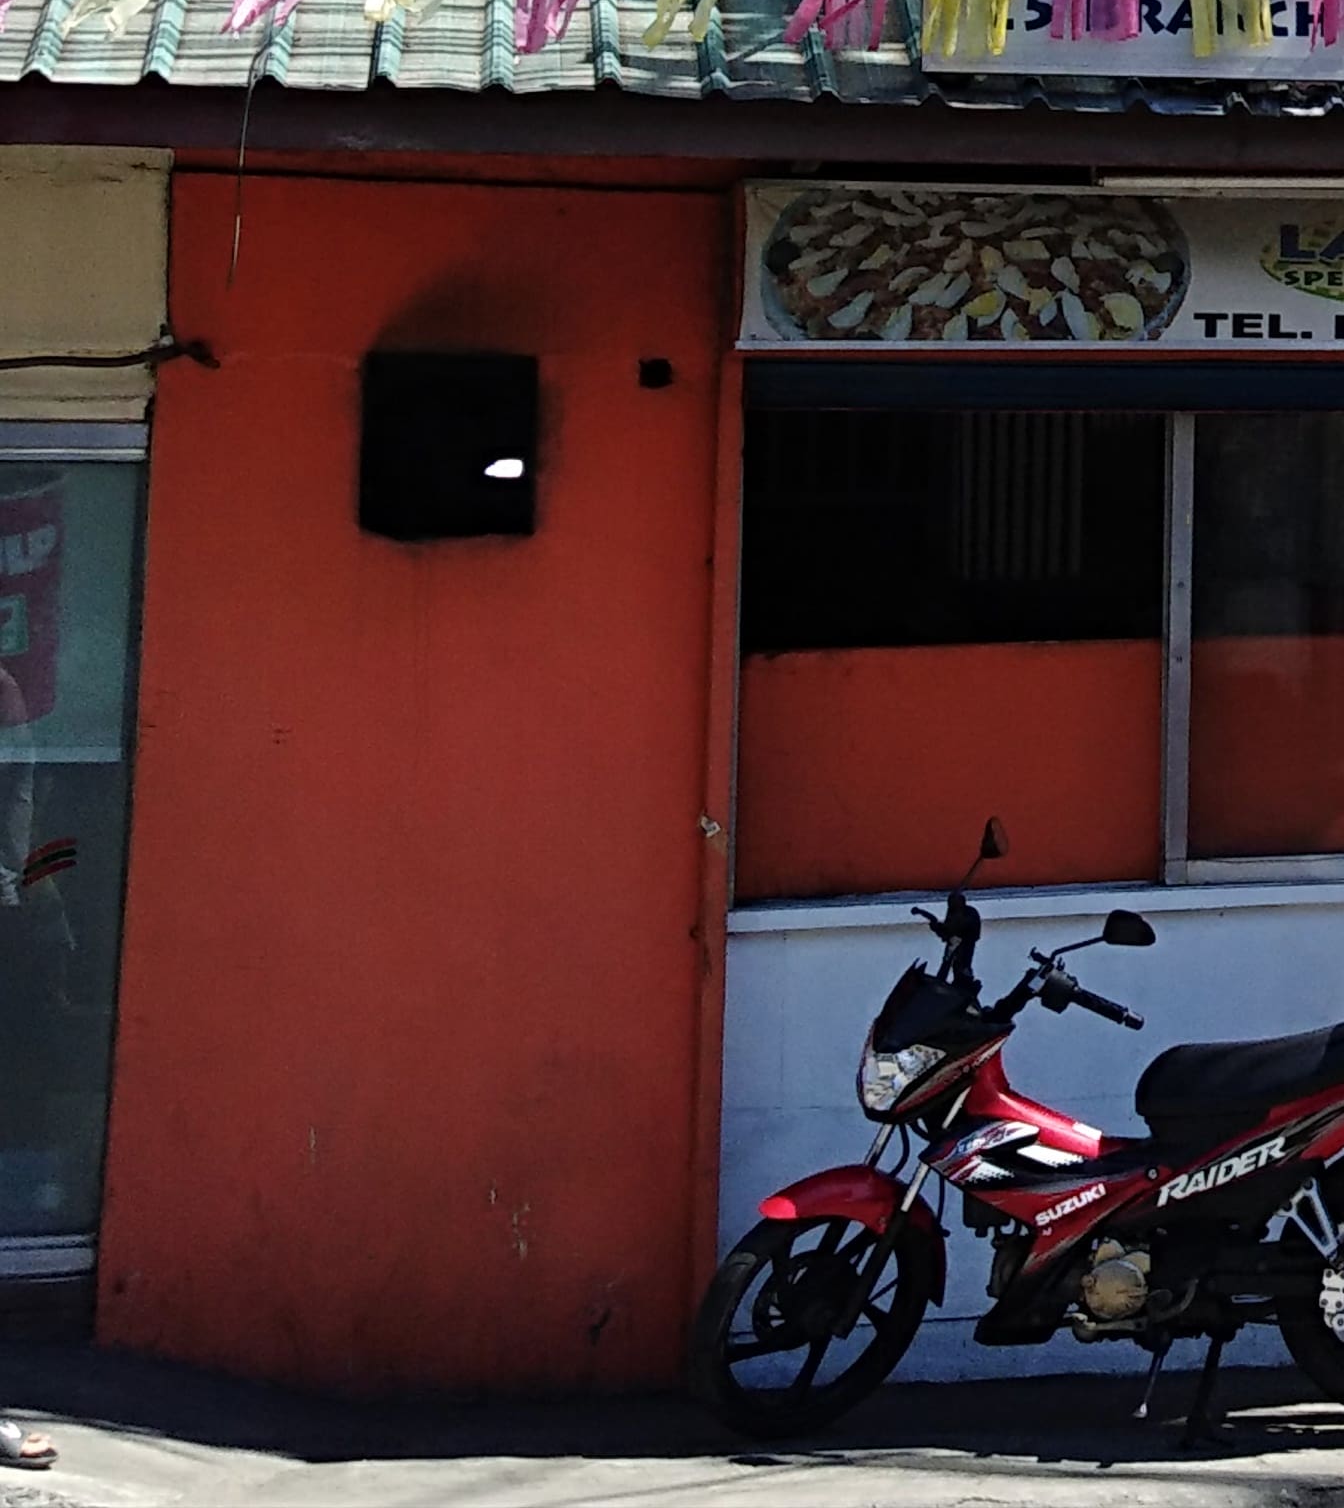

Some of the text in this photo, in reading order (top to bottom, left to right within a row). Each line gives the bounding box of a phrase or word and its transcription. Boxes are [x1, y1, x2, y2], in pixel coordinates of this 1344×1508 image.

[1193, 312, 1313, 340] TEL.
[1156, 1136, 1286, 1208] RAIDER
[1034, 1183, 1107, 1227] SUZUKI
